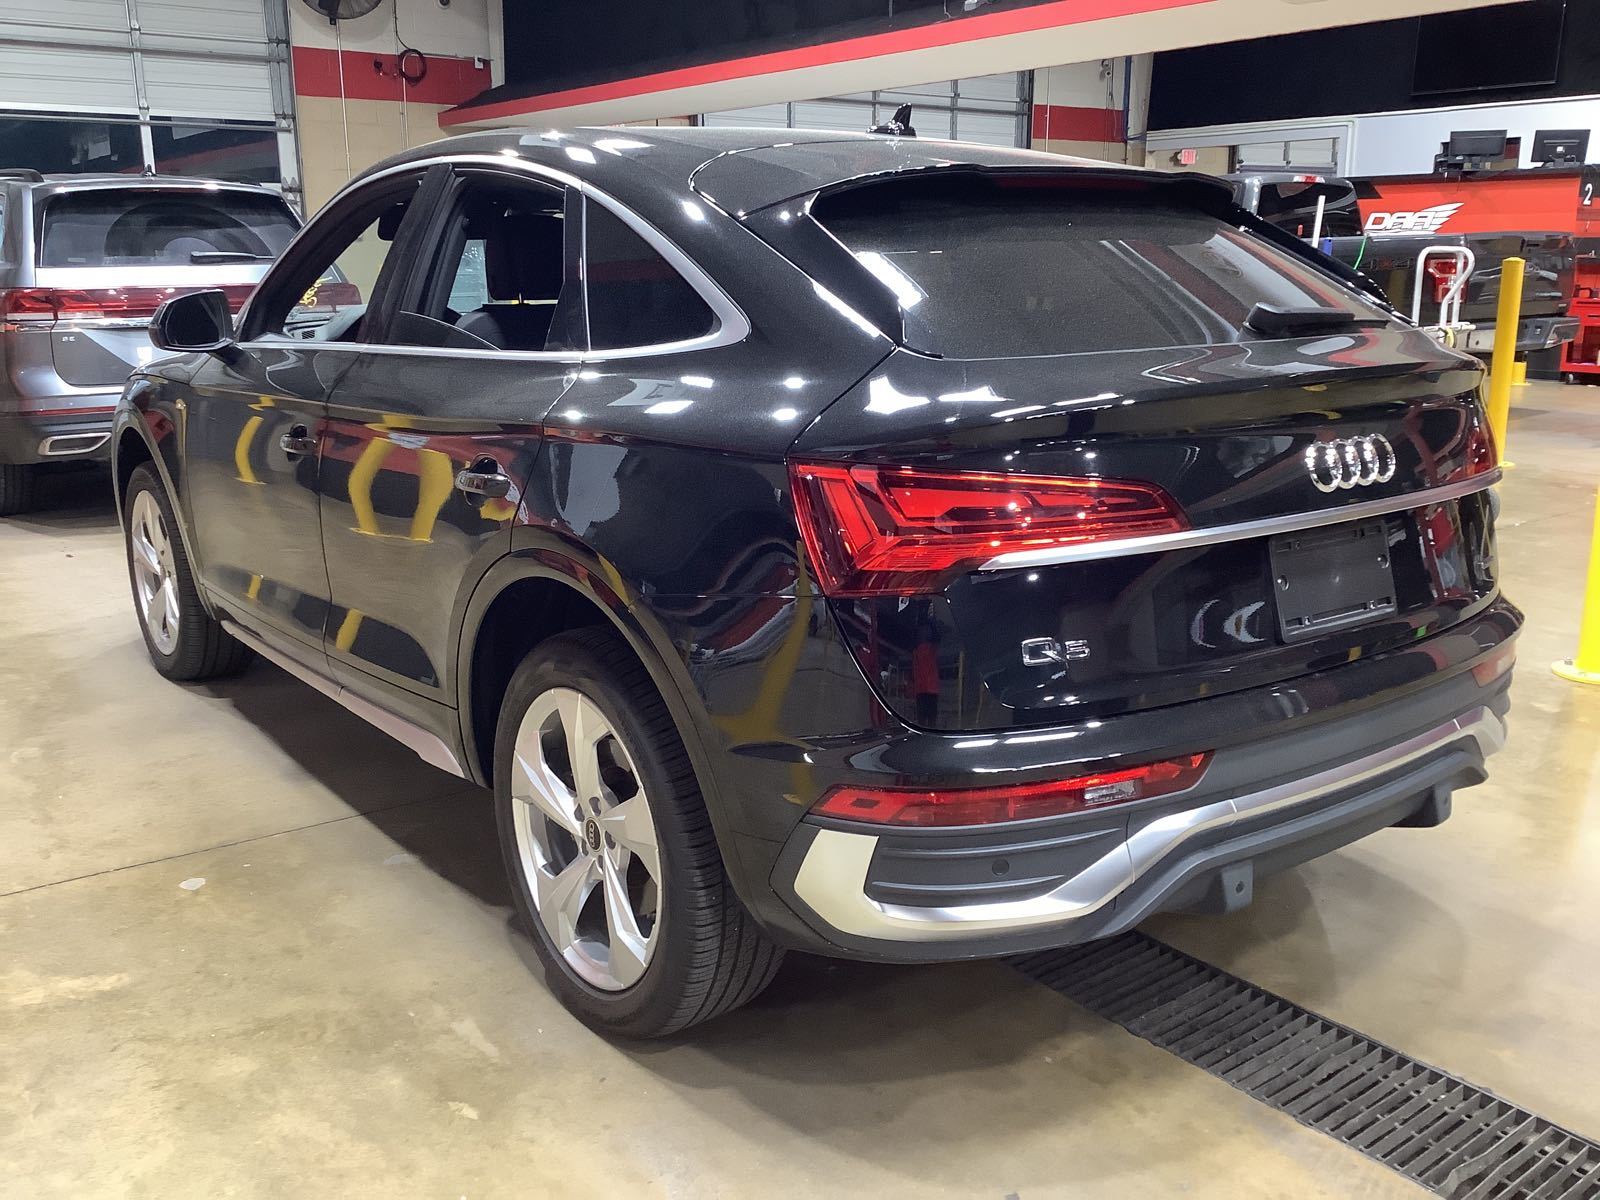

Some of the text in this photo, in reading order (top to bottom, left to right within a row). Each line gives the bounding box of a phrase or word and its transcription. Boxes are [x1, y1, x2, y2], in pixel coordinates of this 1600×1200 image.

[1583, 183, 1593, 205] 2
[1364, 211, 1437, 231] DAA
[1021, 636, 1090, 666] Q5
